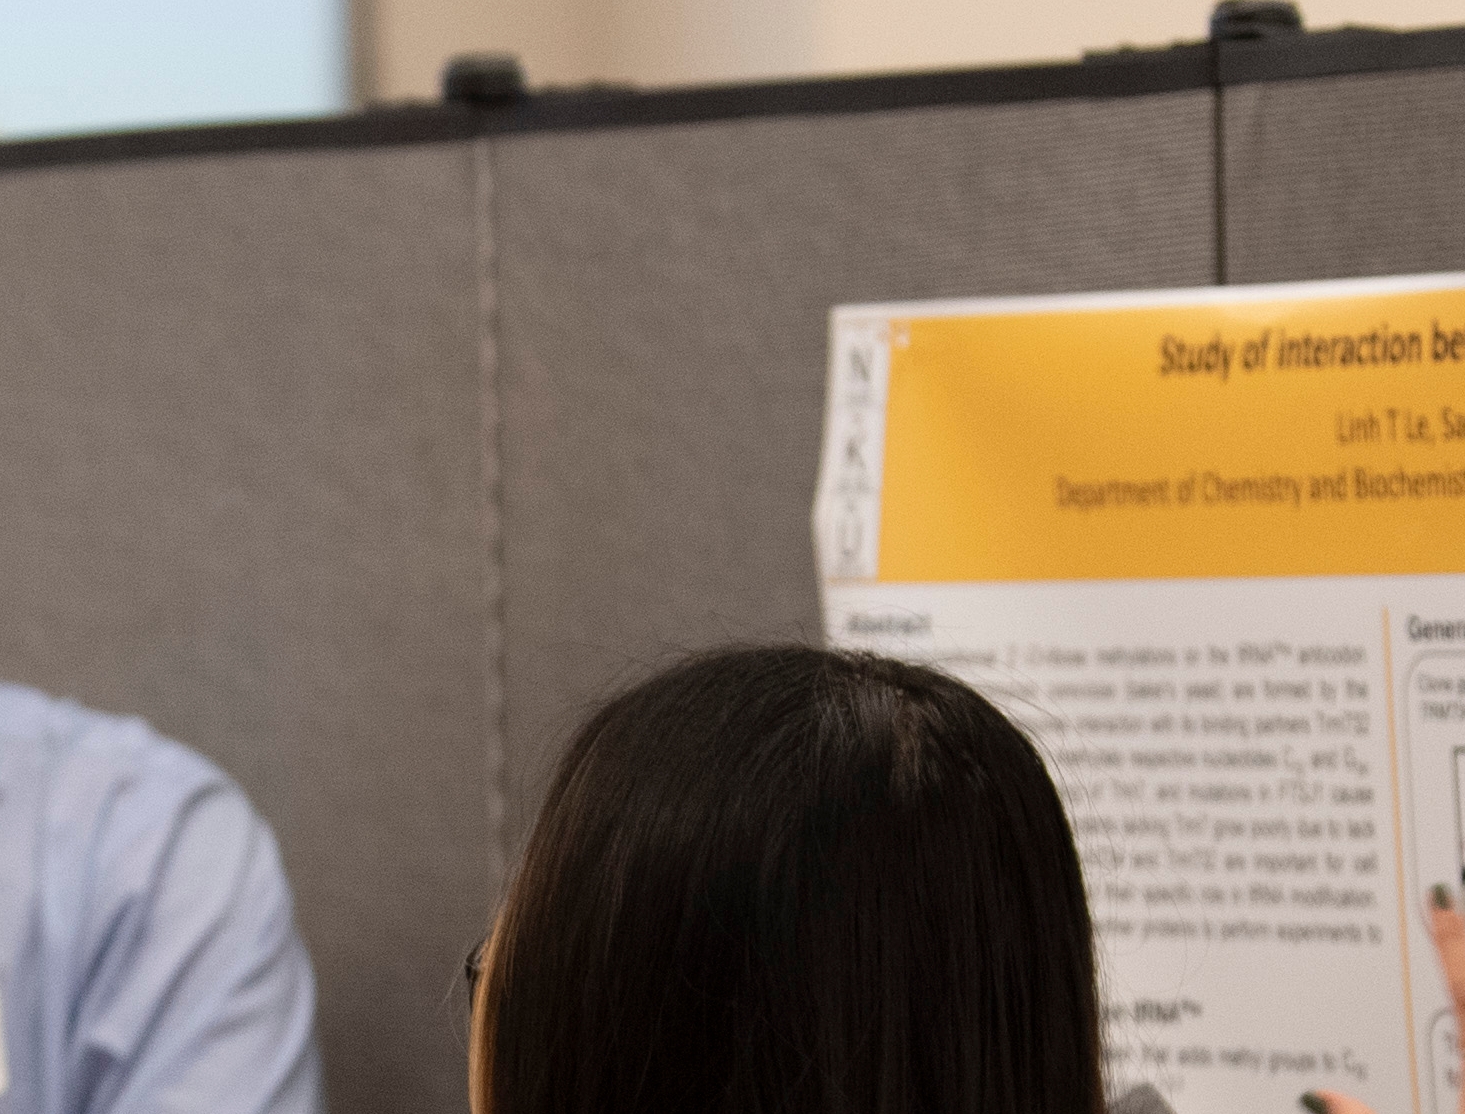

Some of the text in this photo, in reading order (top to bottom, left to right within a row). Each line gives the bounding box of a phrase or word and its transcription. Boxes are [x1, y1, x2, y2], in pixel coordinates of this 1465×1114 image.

[1158, 336, 1238, 381] Study
[1240, 336, 1270, 375] of
[1272, 330, 1423, 371] interaction
[1335, 411, 1382, 446] Linh
[1055, 476, 1172, 511] Department
[1176, 474, 1197, 507] of
[1200, 473, 1303, 506] Chemistry
[1307, 469, 1349, 504] and
